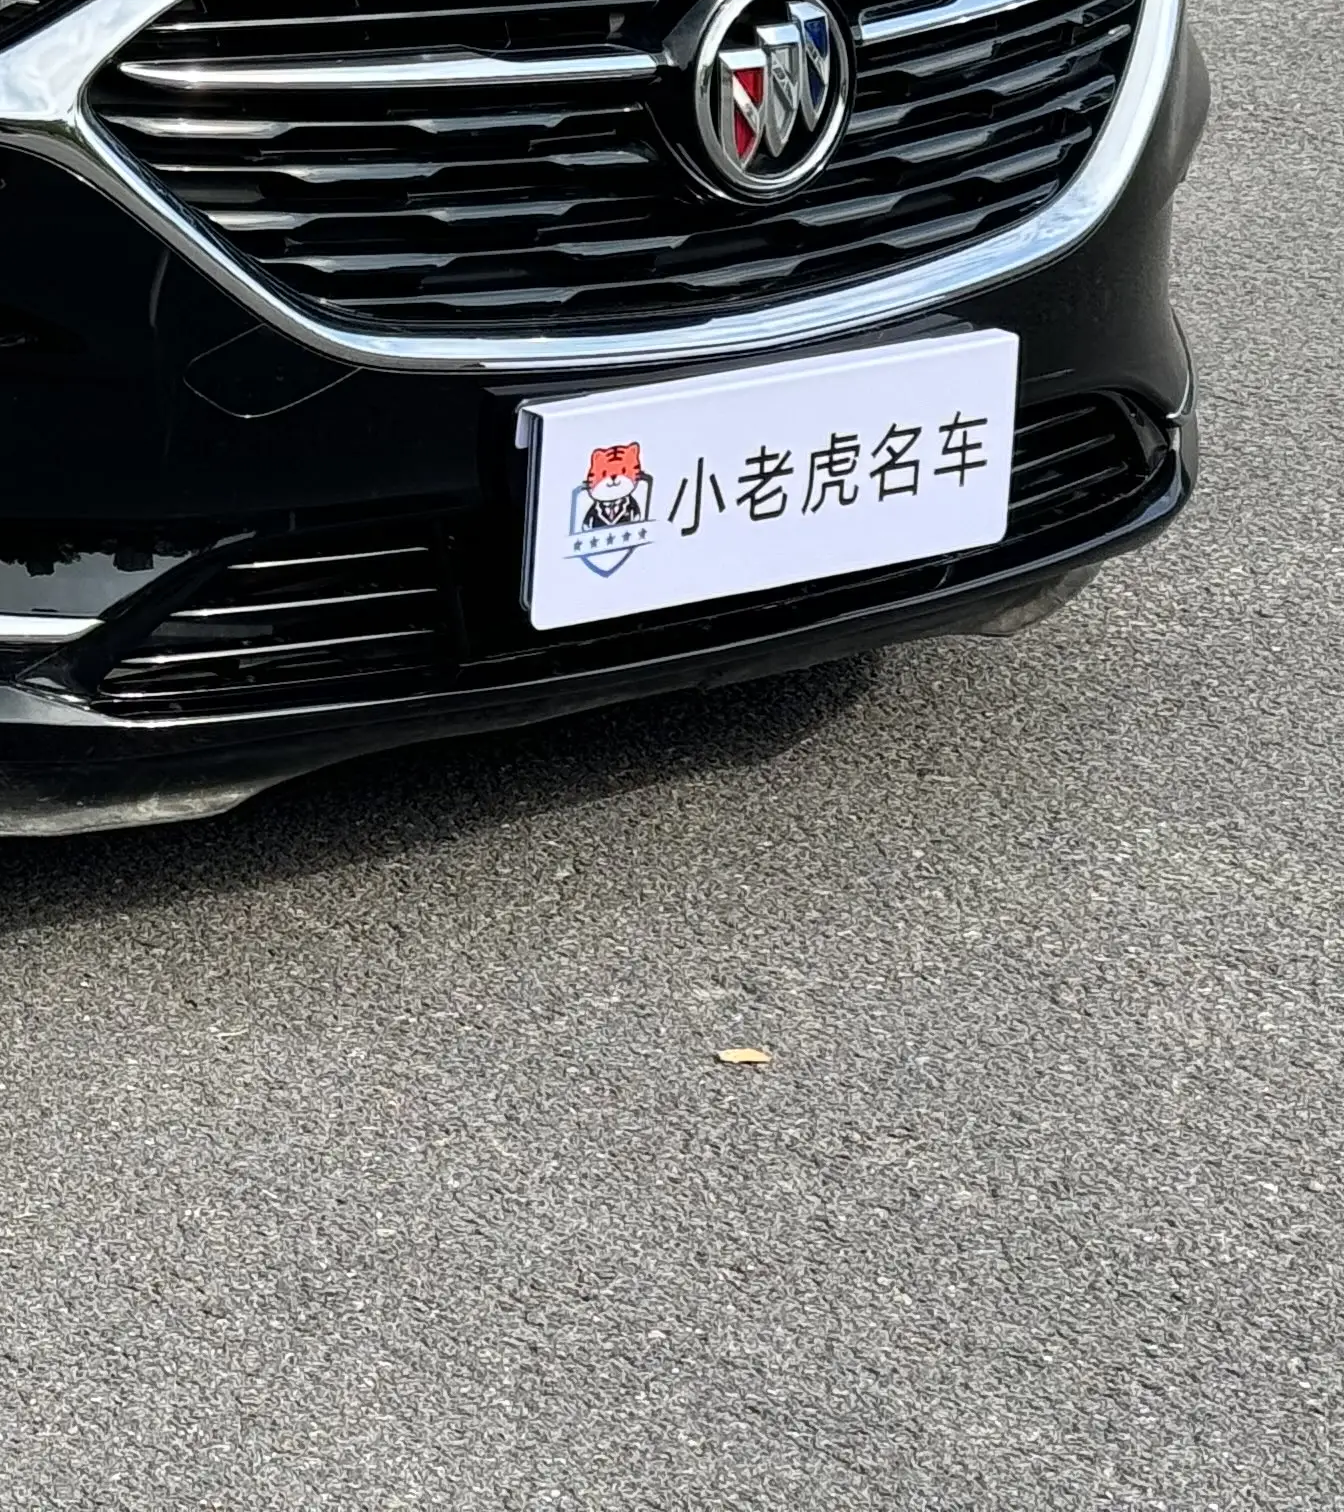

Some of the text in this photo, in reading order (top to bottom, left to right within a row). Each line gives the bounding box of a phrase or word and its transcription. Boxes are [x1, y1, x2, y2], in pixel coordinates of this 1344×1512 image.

[666, 410, 988, 537] 小老虎名车
